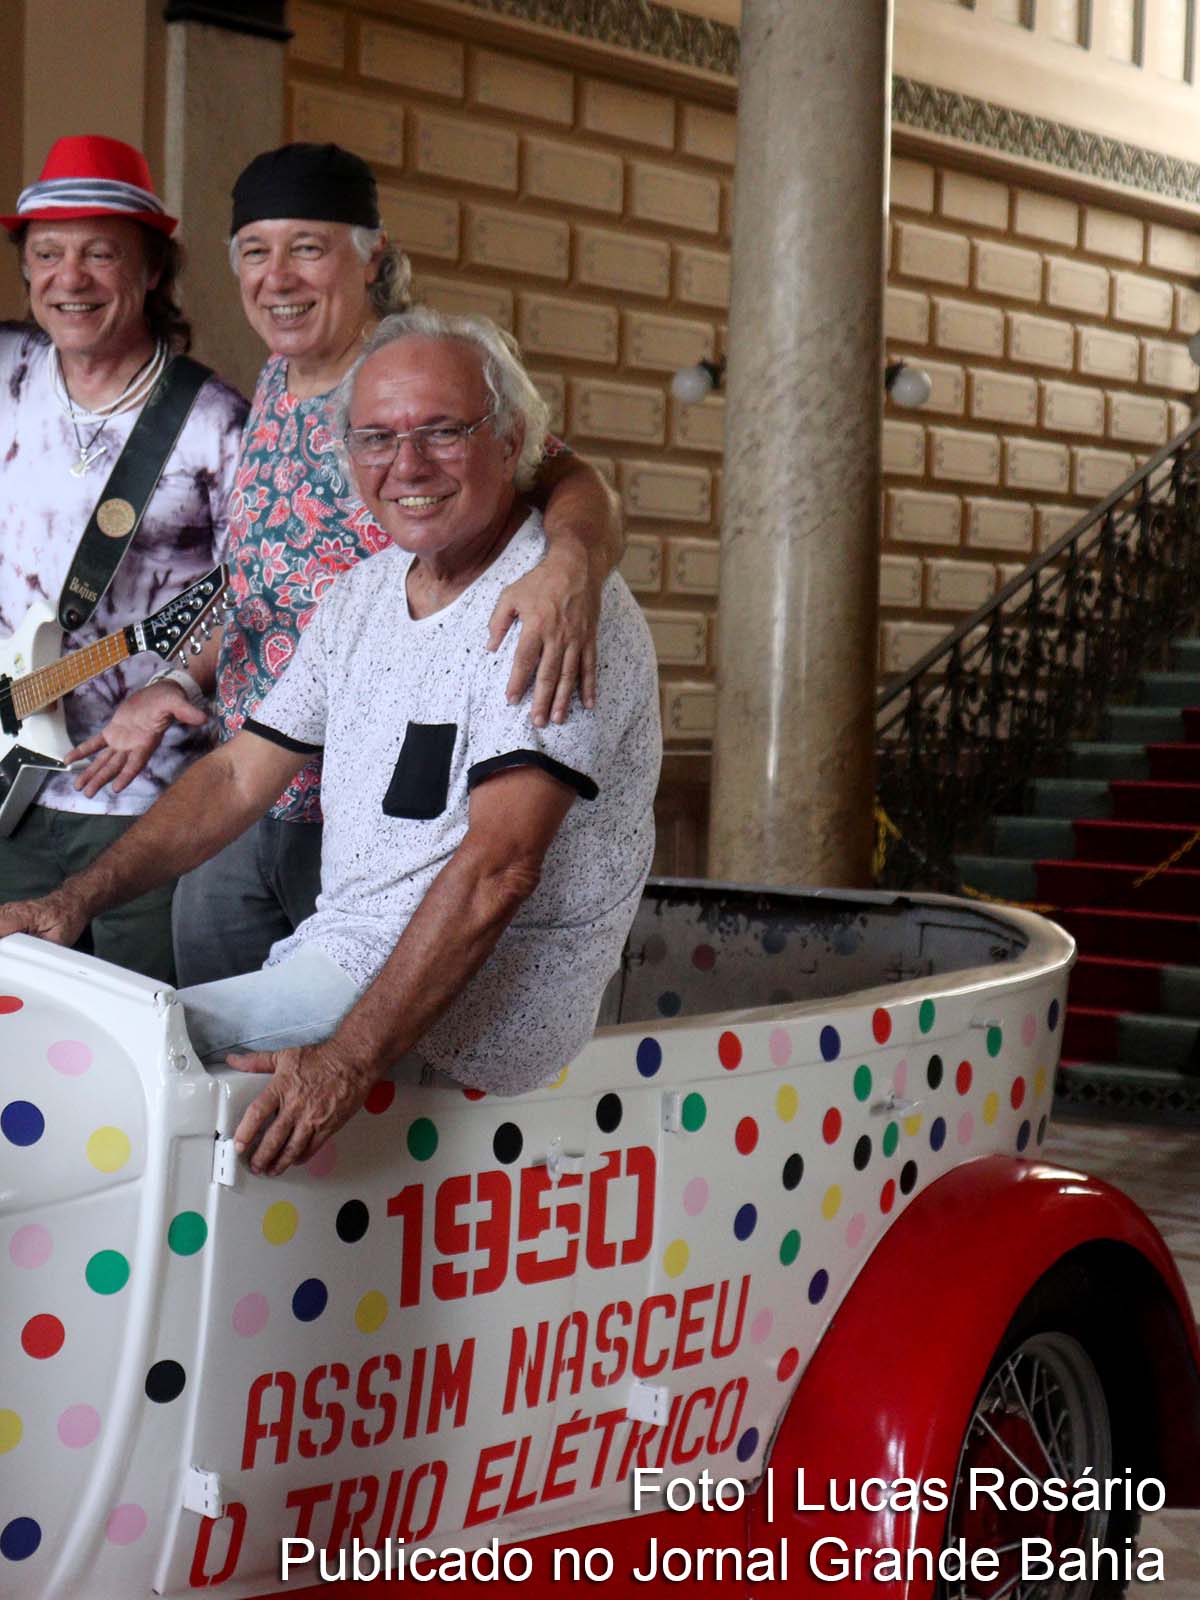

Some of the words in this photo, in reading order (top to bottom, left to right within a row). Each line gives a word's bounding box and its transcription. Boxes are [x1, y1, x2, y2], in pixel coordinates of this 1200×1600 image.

[387, 1145, 657, 1309] 1950
[241, 1337, 476, 1471] ASSIM
[502, 1274, 751, 1415] NASCEU
[188, 1501, 248, 1589] O
[286, 1460, 448, 1570] TRIO
[462, 1376, 749, 1530] ELÉTRICO
